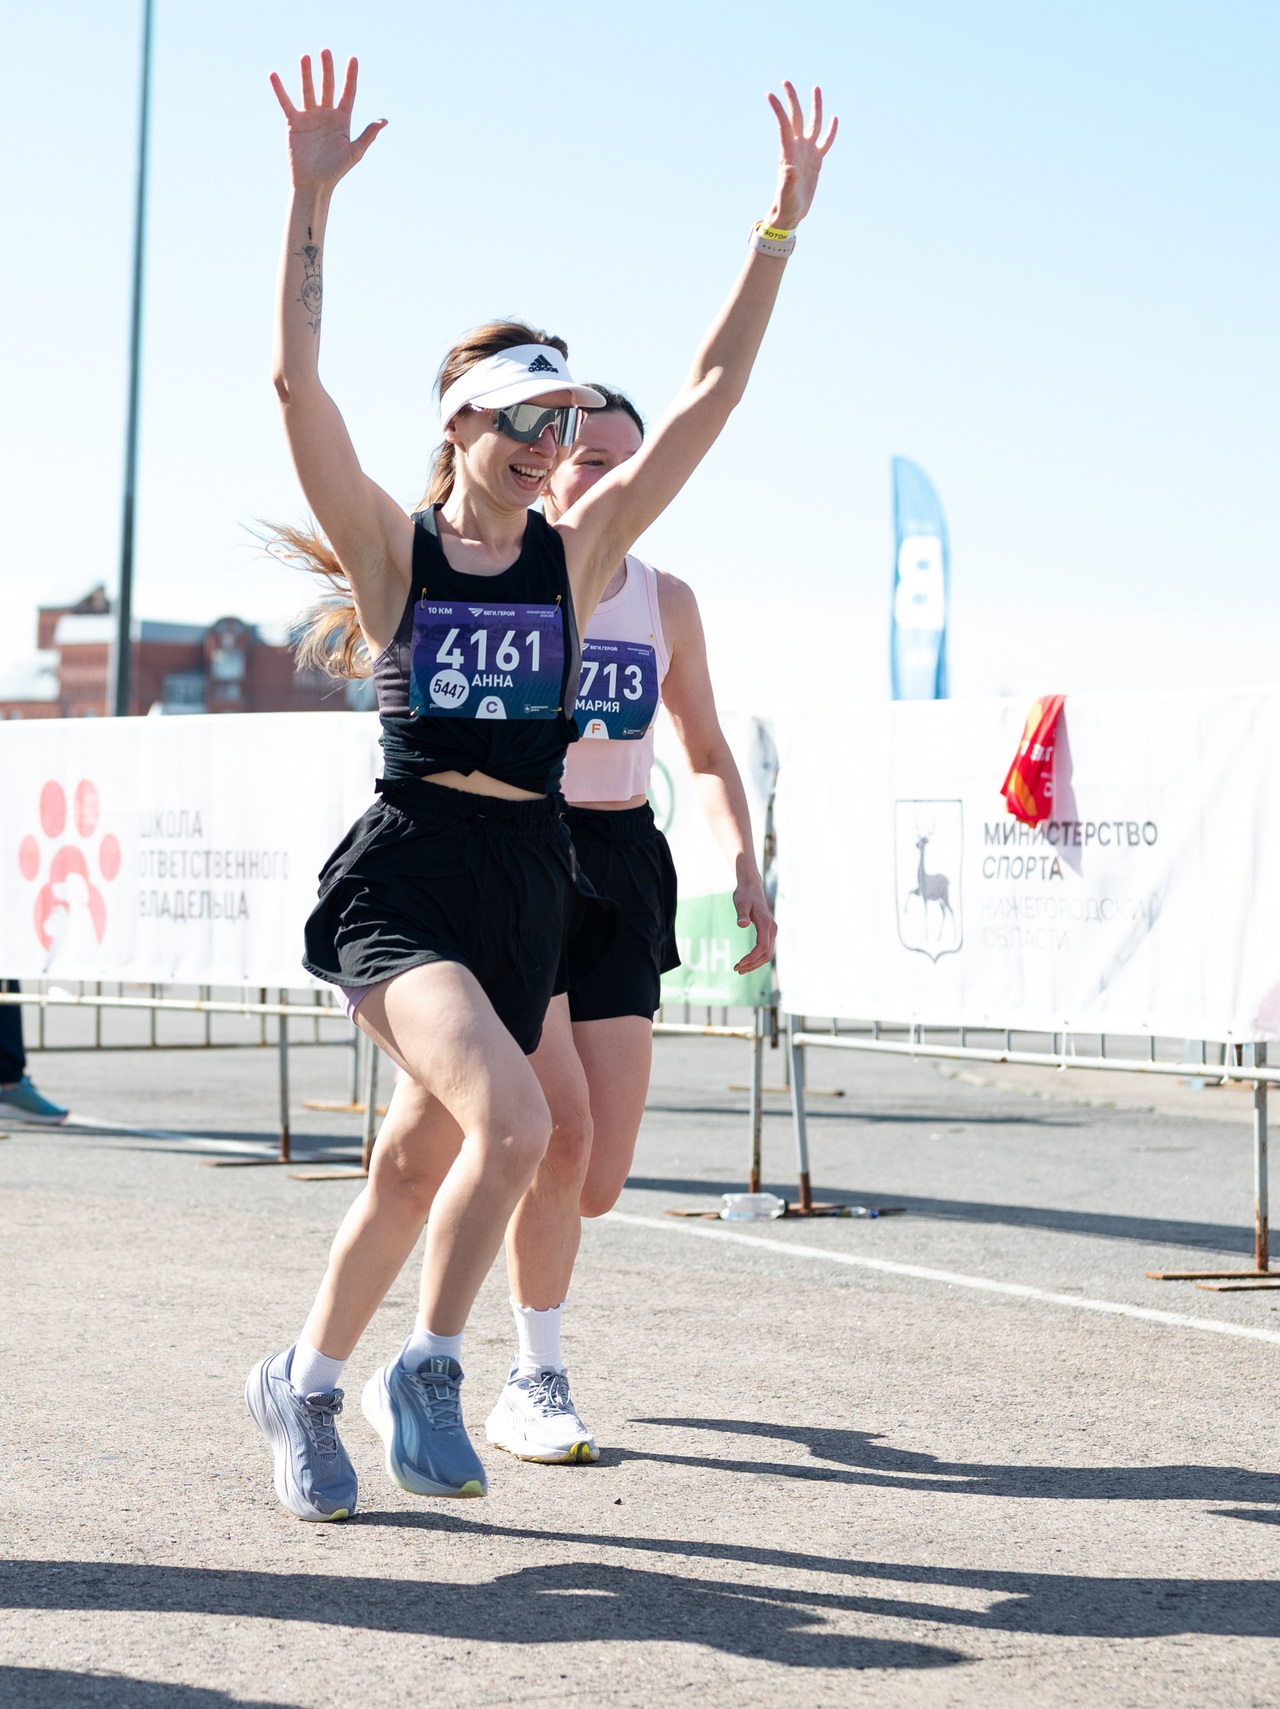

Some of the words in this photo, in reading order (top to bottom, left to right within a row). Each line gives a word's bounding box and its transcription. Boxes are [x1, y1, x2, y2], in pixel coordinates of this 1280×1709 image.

[528, 364, 559, 374] adidas
[436, 628, 540, 672] 4161
[433, 678, 466, 700] 5447
[471, 673, 513, 688] АННА
[575, 698, 620, 713] МАРИЯ
[591, 723, 601, 734] F
[139, 809, 203, 838] ШКОЛА
[983, 821, 1158, 847] МИНИСТЕРСТВО
[138, 850, 290, 880] ОТВЕТСТВЕННОГО
[982, 855, 1064, 881] СПОРТА
[139, 889, 250, 924] ВЛАДЕЛЬЦА
[981, 895, 1147, 924] НИЖЕГОРОДСКЙ
[981, 926, 1070, 951] ОБЛАСТИ
